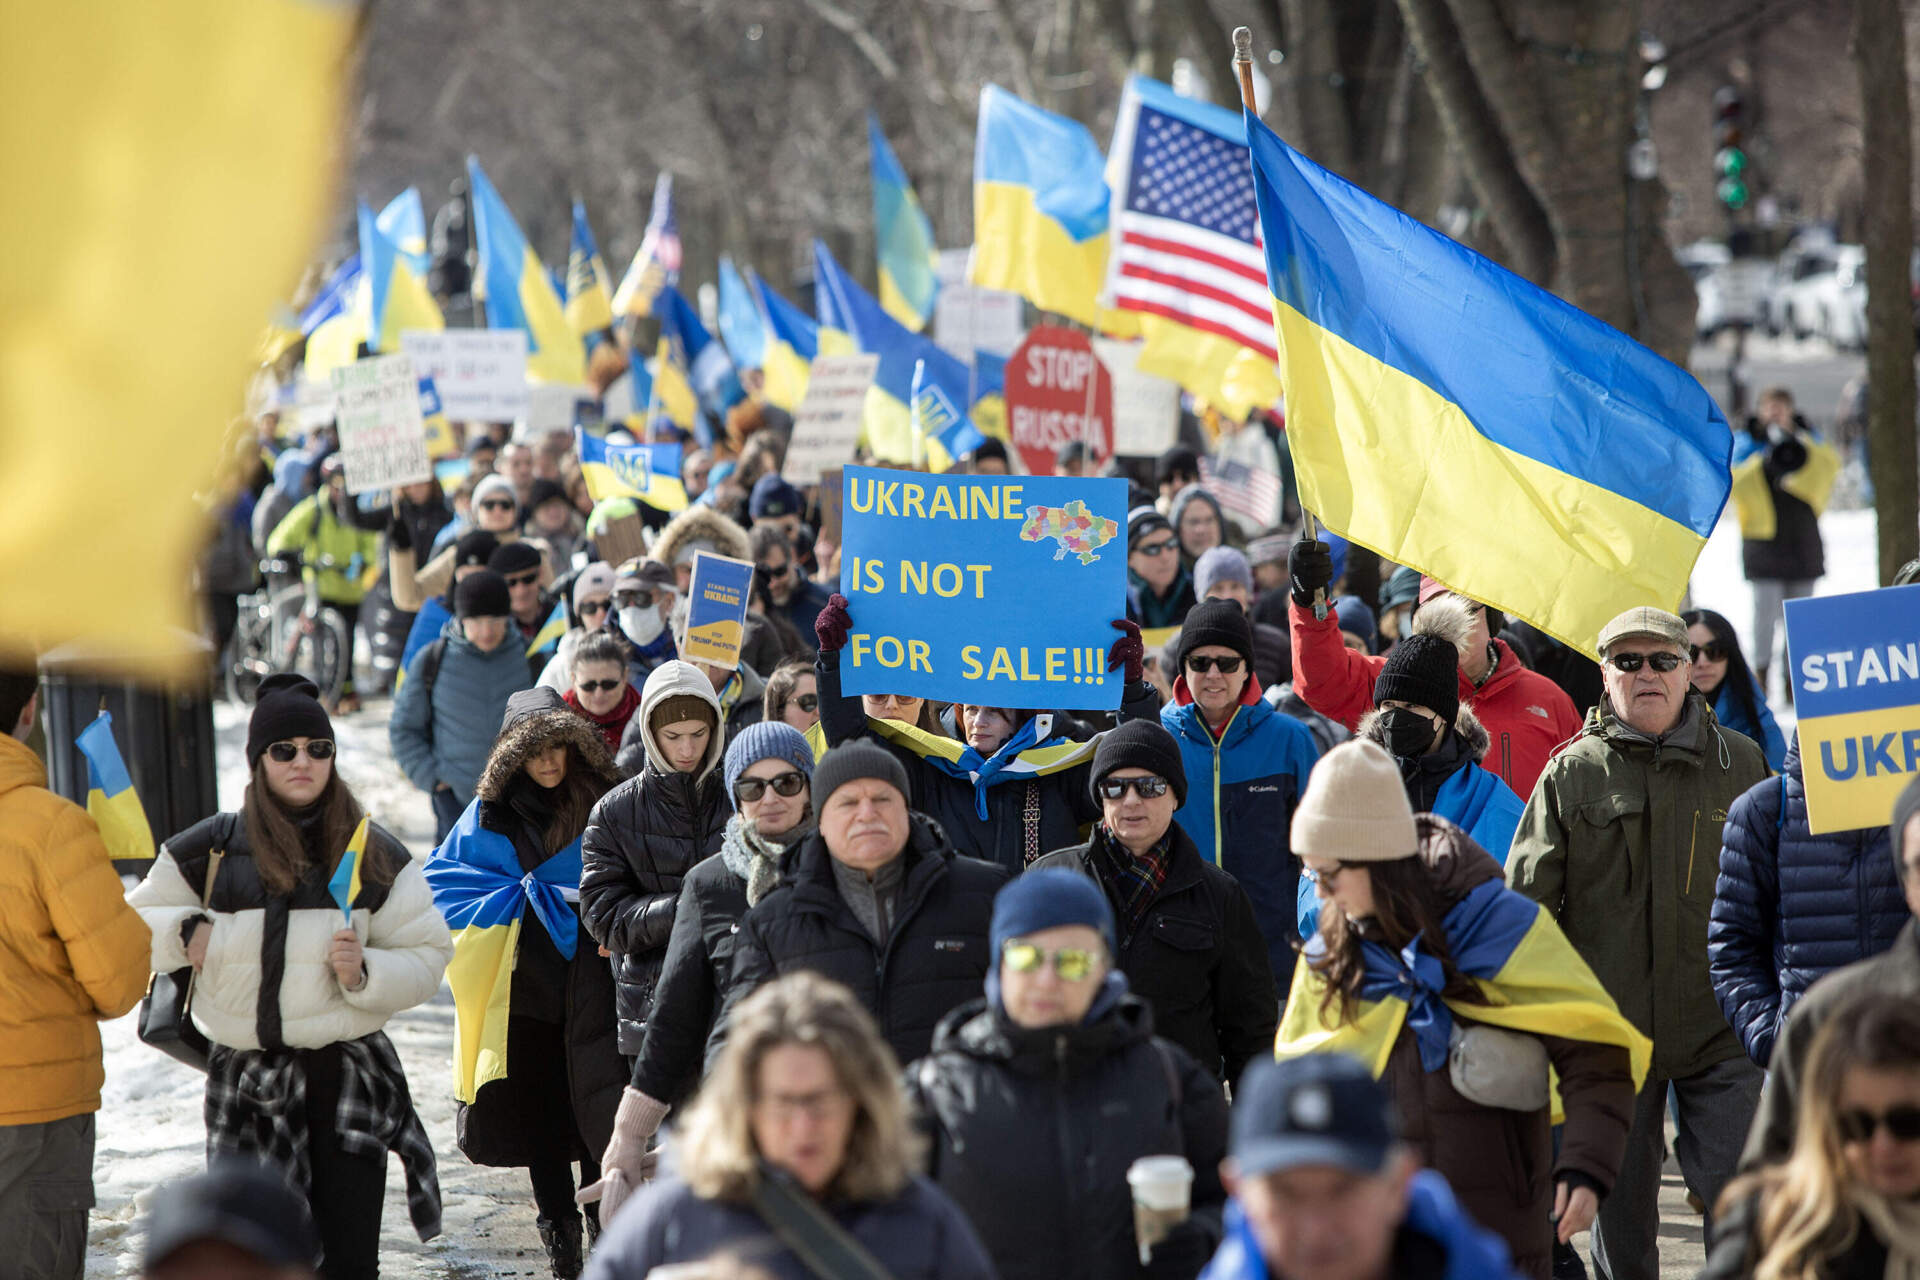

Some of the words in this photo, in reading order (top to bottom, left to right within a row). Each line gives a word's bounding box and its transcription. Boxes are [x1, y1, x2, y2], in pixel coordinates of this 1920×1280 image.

[1026, 345, 1090, 391] STOP
[850, 477, 1024, 520] UKRAINE
[704, 590, 739, 605] UKRAINE
[852, 557, 884, 594] IS
[900, 560, 992, 599] NOT
[691, 634, 712, 645] TRUMP
[852, 634, 934, 674] FOR
[961, 645, 1105, 685] SALE!!!
[1802, 643, 1920, 692] STAN
